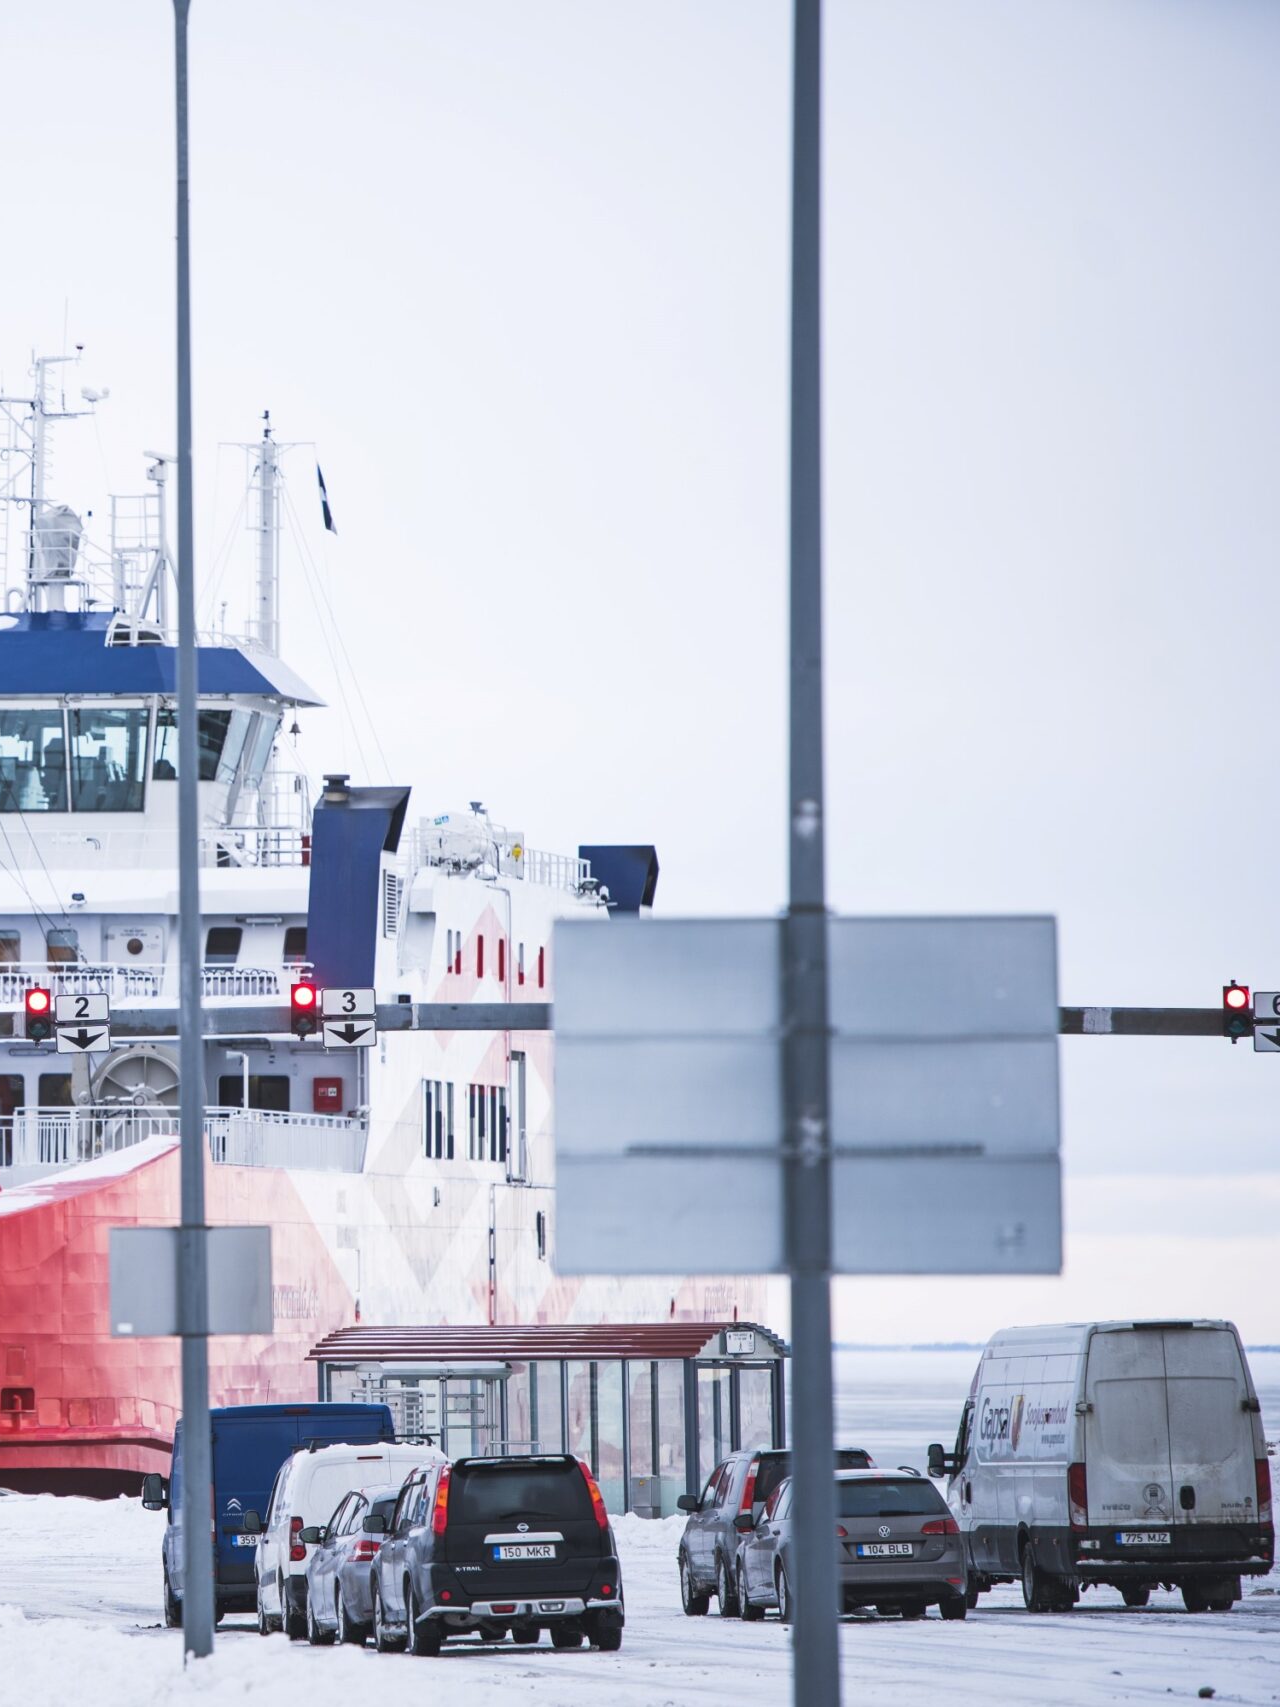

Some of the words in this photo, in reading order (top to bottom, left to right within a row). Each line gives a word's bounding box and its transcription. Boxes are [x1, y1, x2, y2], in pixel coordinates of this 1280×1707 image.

[75, 996, 89, 1018] 2
[342, 992, 356, 1013] 3
[240, 1535, 256, 1545] 359
[1125, 1534, 1143, 1543] 775
[1147, 1533, 1168, 1543] MJZ
[504, 1547, 522, 1558] 150
[526, 1546, 551, 1557] MKR
[868, 1545, 884, 1554] 104
[888, 1544, 910, 1554] BLB
